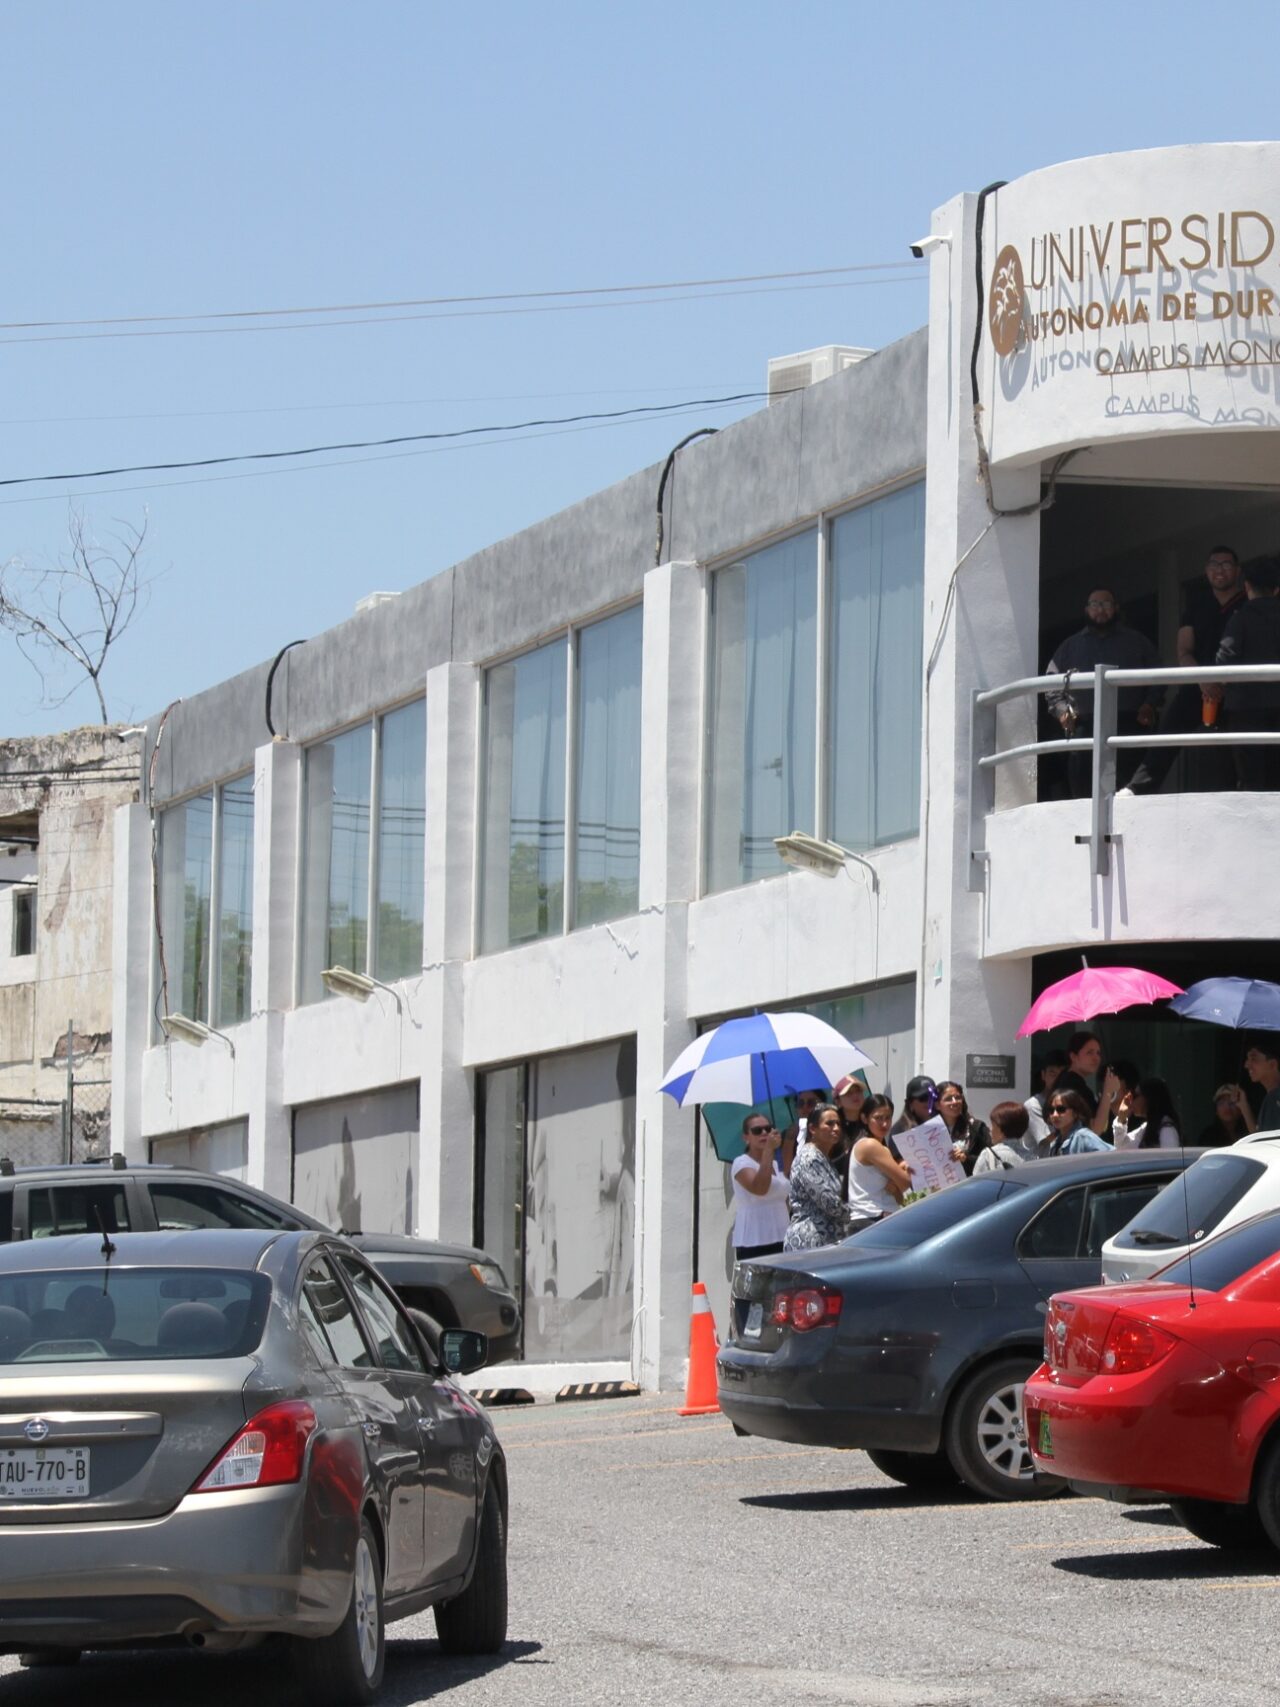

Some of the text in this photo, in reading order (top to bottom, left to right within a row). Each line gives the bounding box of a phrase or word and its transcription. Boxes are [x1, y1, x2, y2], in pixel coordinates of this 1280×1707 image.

[1020, 297, 1149, 343] AUTONOMA
[1163, 292, 1197, 322] DE
[1097, 343, 1191, 374] CAMPUS
